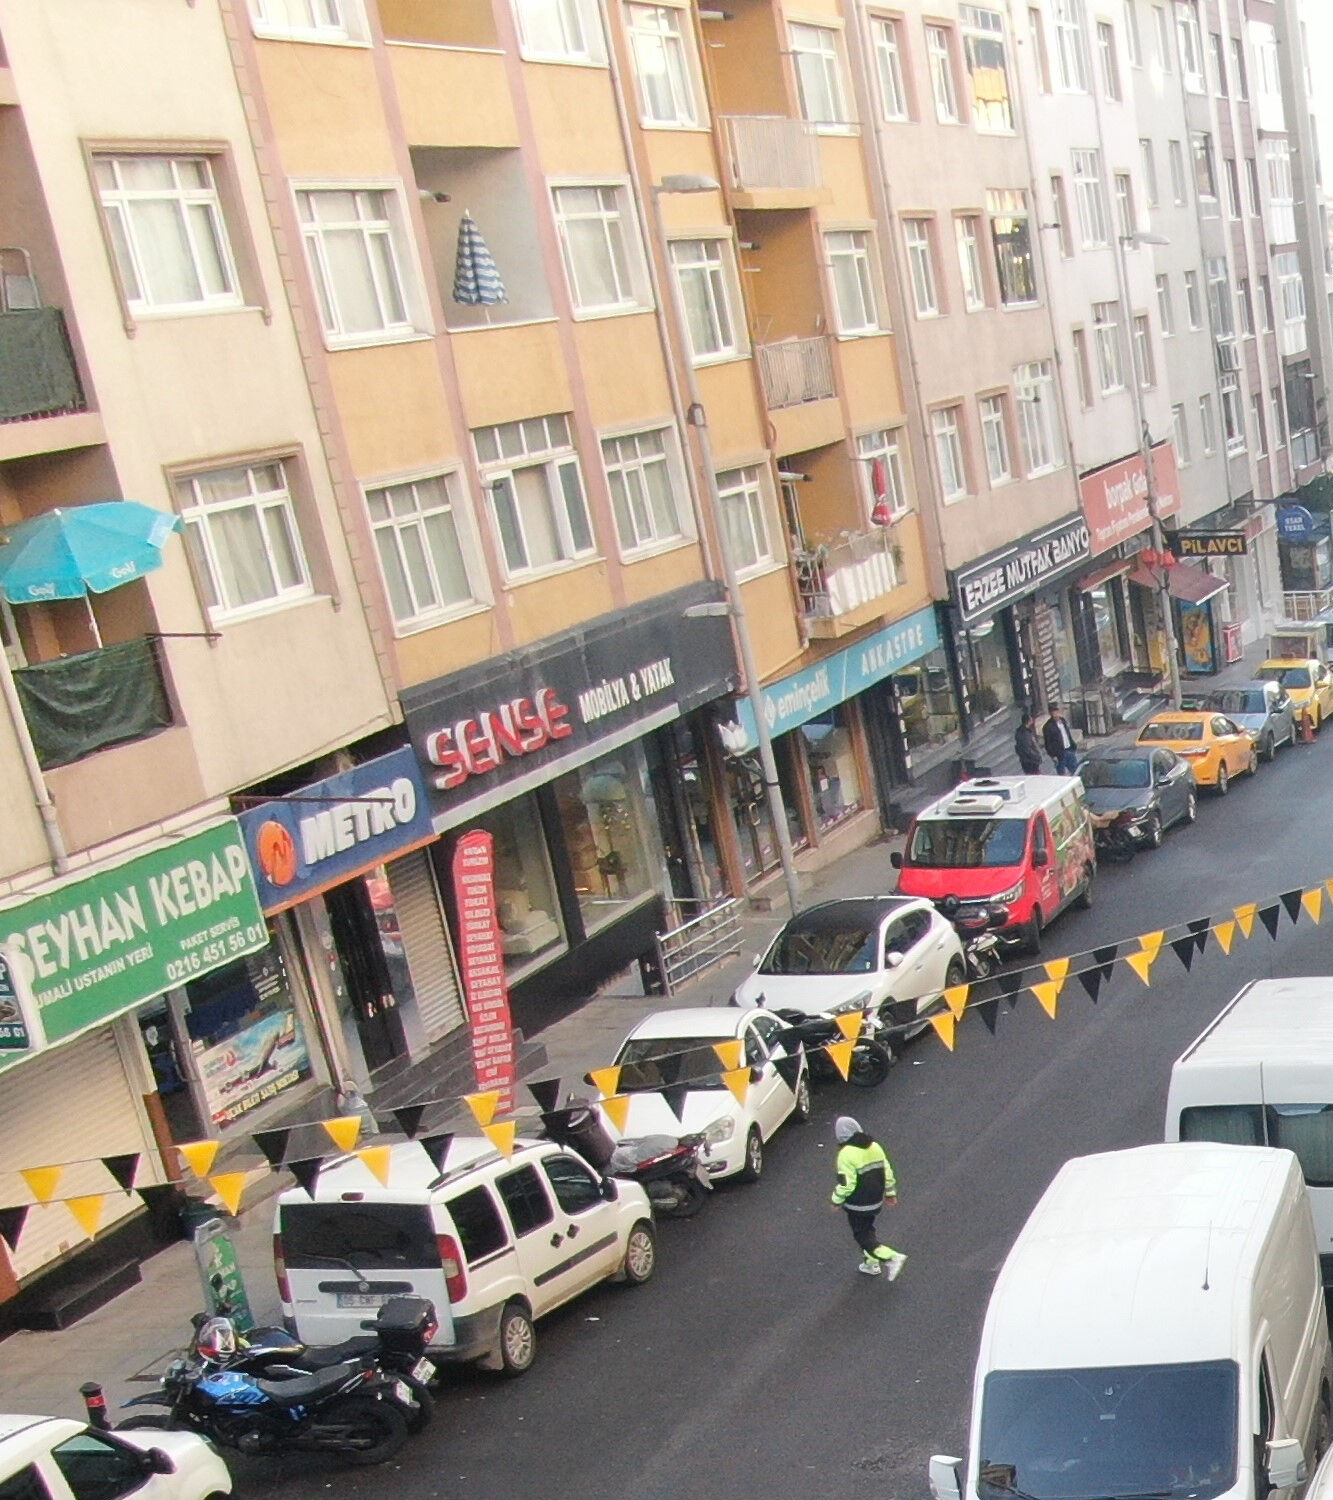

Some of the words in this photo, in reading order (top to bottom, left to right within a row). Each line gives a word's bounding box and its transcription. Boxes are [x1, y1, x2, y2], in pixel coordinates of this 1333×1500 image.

[1006, 544, 1053, 589] MUTFAK
[427, 688, 574, 790] SENSE
[579, 678, 631, 724] MOBİLYA
[639, 656, 676, 695] YATAK
[300, 777, 416, 865] METRO
[149, 844, 250, 927] KEBAP
[74, 957, 126, 991] USTANIN
[126, 941, 155, 966] YERİ
[166, 957, 201, 981] 0216
[203, 940, 227, 964] 451
[229, 930, 246, 952] 56
[248, 923, 263, 944] 01
